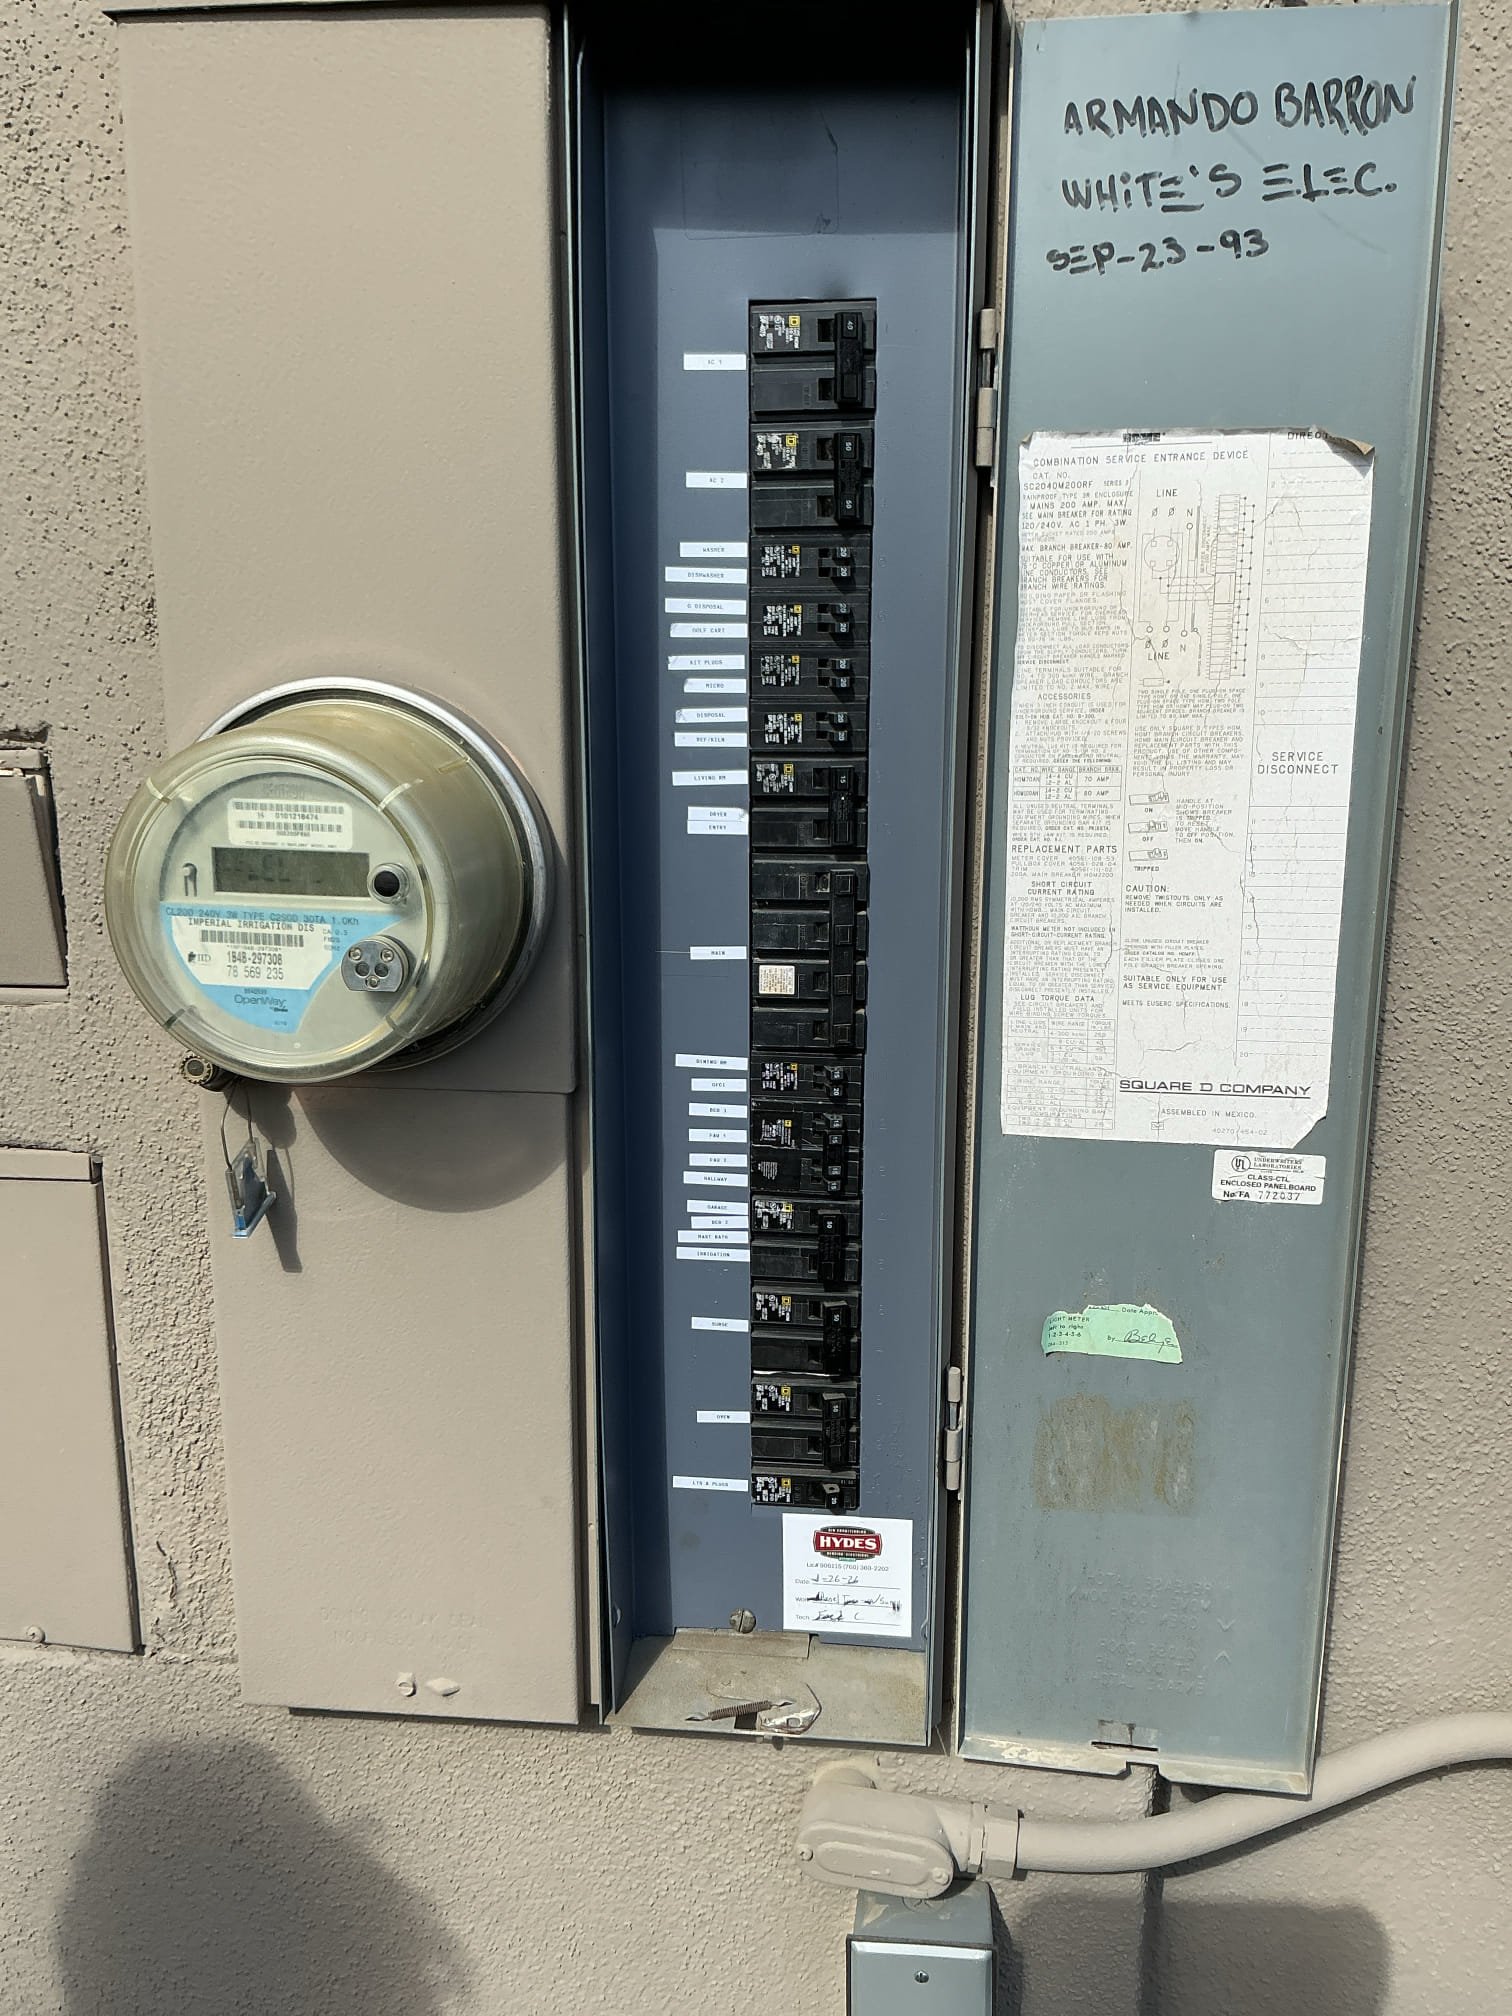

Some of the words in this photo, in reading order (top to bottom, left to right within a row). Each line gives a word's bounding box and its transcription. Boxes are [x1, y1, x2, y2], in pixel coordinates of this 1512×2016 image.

[1064, 88, 1259, 138] ARMANDO
[1274, 74, 1417, 136] BARRON
[1045, 228, 1269, 275] SEP-23-93
[1033, 456, 1099, 467] COMBINATION
[1106, 454, 1146, 464] SERVICE
[1154, 452, 1206, 463] ENTRANCE
[1213, 450, 1249, 460] DEVICE
[1156, 488, 1178, 498] LINE
[1030, 502, 1055, 510] MAINS
[1060, 501, 1076, 509] 200
[1037, 511, 1054, 519] MAIN
[1057, 510, 1087, 518] BREAKER
[1091, 509, 1104, 517] FOR
[1069, 520, 1080, 528] AC
[840, 547, 847, 557] 20
[1076, 553, 1091, 561] USE
[1042, 561, 1070, 569] COPPER
[840, 567, 848, 577] 20
[840, 623, 847, 633] 20
[1147, 651, 1170, 661] LINE
[839, 659, 847, 669] 20
[840, 678, 847, 688] 20
[1038, 692, 1092, 701] ACCESSORIES
[1271, 751, 1324, 763] SERVICE
[1256, 763, 1340, 776] DISCONNECT
[840, 775, 847, 784] 15
[1011, 845, 1081, 854] REPLACEMENT
[1086, 845, 1118, 854] PARTS
[1125, 884, 1170, 892] CAUTION:
[199, 910, 220, 919] 240V
[242, 911, 265, 920] TYPE
[188, 918, 232, 928] IMPERIAL
[237, 919, 293, 930] IRRIGATION
[298, 922, 315, 932] DIS
[226, 965, 239, 977] 78
[243, 966, 261, 979] 569
[266, 967, 284, 980] 235
[1166, 975, 1186, 983] ONLY
[1175, 983, 1224, 991] EQUIPMENT.
[1041, 994, 1070, 1002] TORQUE
[1175, 1000, 1231, 1009] SPECIFICATIONS.
[834, 1071, 840, 1079] 15
[833, 1087, 840, 1096] 20
[1119, 1079, 1193, 1091] SQUARE
[1199, 1082, 1213, 1092] D
[1219, 1083, 1311, 1095] COMPANY
[1161, 1108, 1207, 1117] ASSEMBLED
[1225, 1110, 1257, 1119] MEXICO.
[833, 1120, 839, 1128] 15
[1220, 1180, 1262, 1188] ENCLOSED
[1264, 1182, 1316, 1192] PANELBOARD
[1258, 1191, 1301, 1201] 772037
[820, 1536, 877, 1550] HYDES
